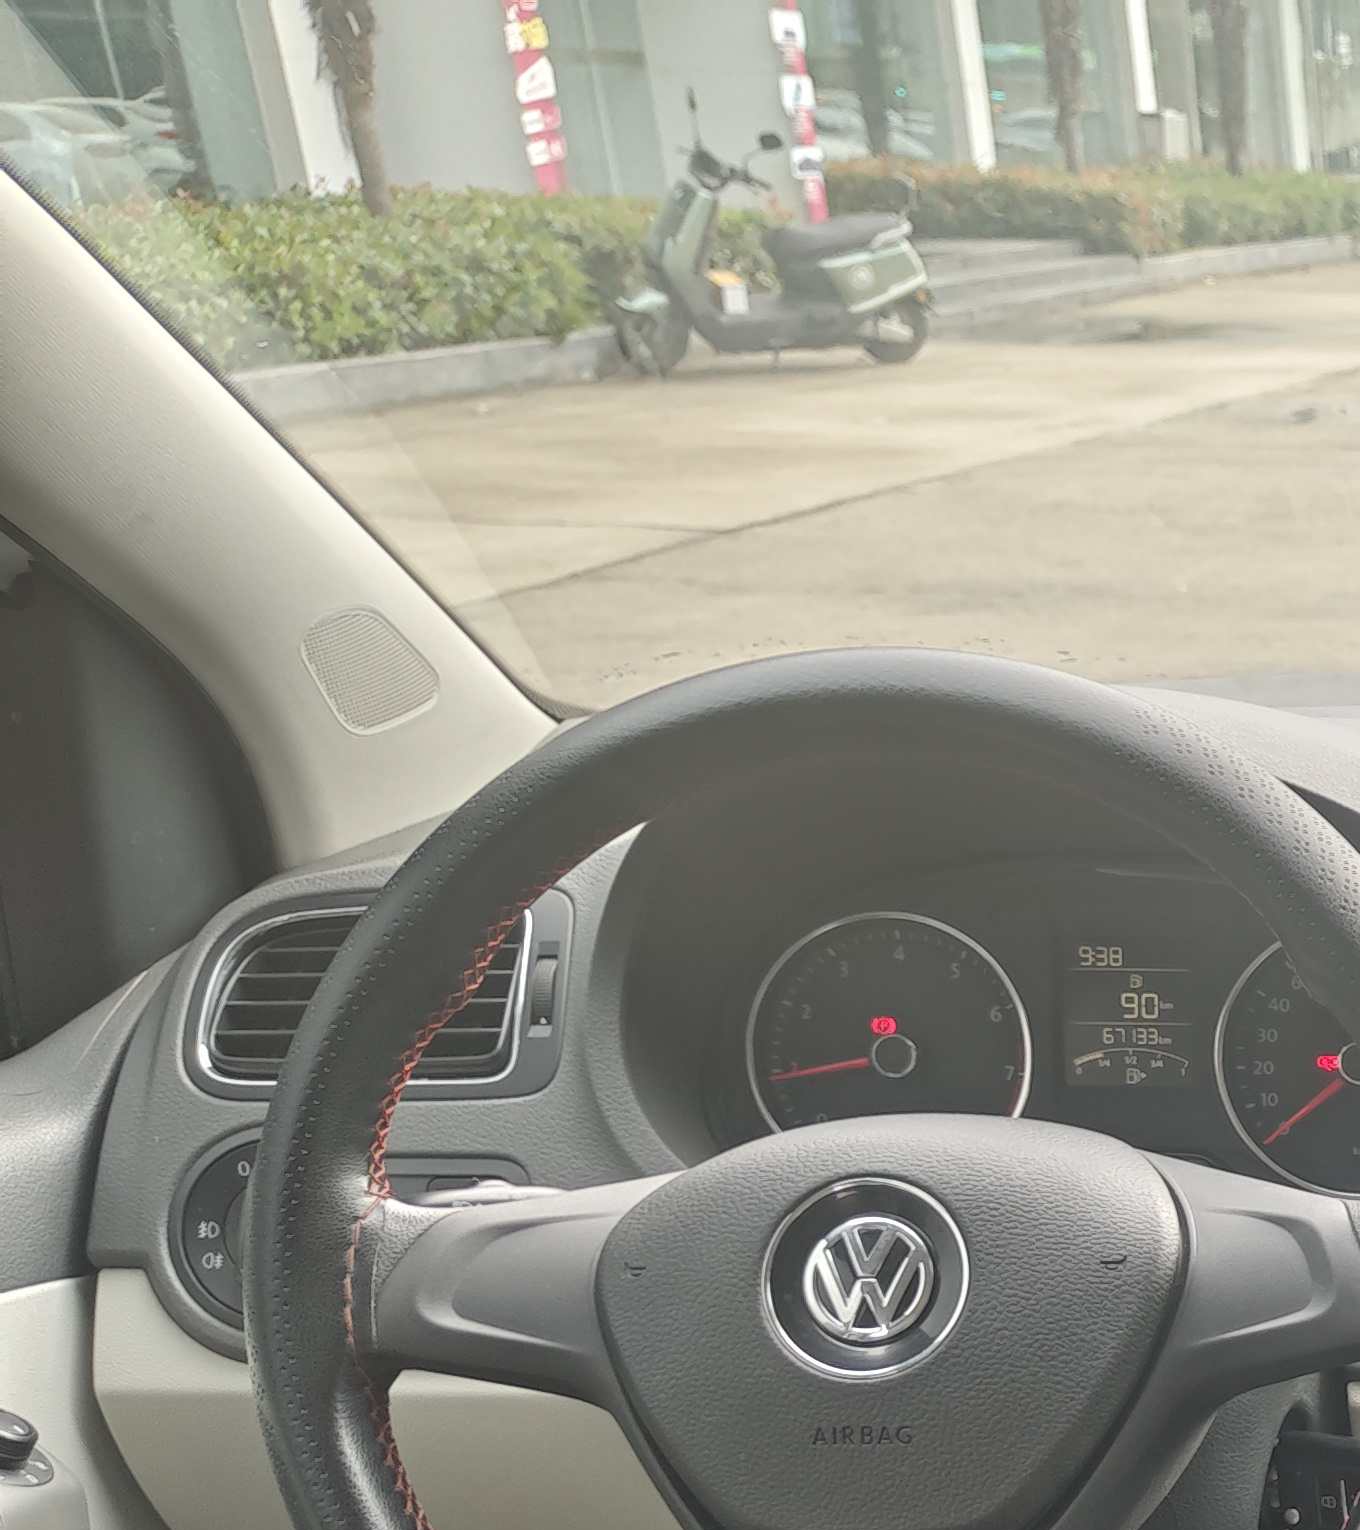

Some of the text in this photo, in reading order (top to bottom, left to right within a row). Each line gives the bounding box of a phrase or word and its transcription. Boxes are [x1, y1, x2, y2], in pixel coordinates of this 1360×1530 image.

[893, 946, 905, 961] 4
[1078, 946, 1123, 967] 9:38
[949, 964, 961, 979] 5
[801, 1004, 811, 1019] 2
[1121, 993, 1159, 1019] 90
[1269, 998, 1290, 1013] 40
[990, 1008, 1002, 1023] 6
[1103, 1027, 1158, 1045] 67133
[1257, 1028, 1278, 1043] 30
[1004, 1066, 1014, 1081] 7
[1253, 1060, 1274, 1075] 20
[1261, 1092, 1279, 1107] 10
[812, 1426, 914, 1446] AIRBAG
